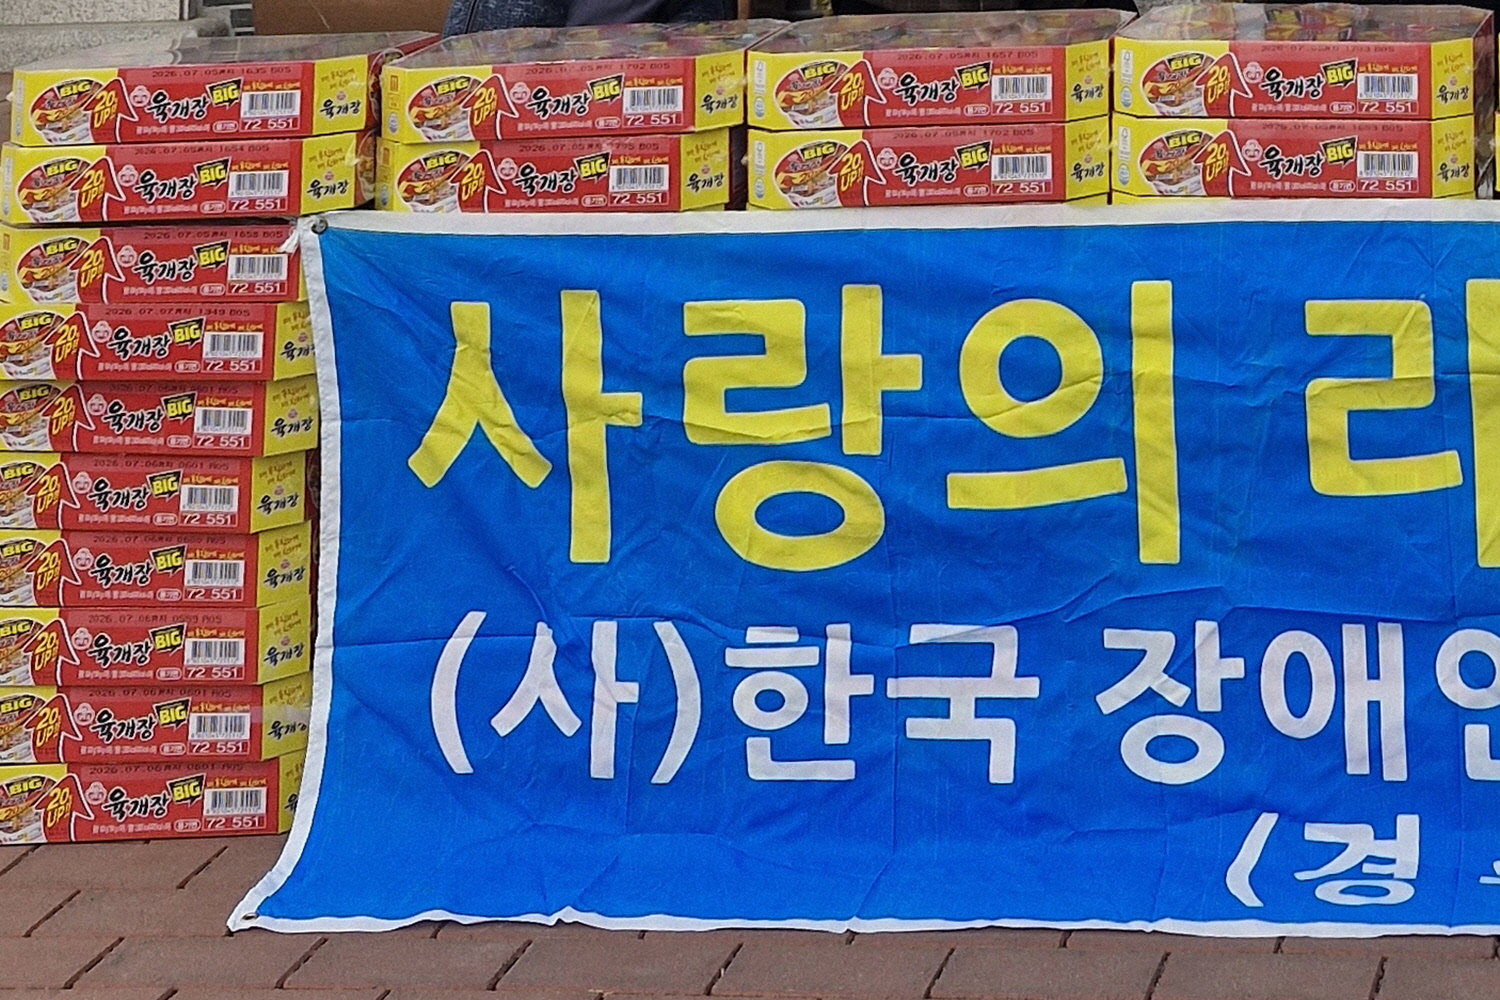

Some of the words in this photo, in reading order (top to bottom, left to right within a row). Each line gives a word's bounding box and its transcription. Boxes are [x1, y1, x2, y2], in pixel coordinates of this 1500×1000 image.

[804, 63, 836, 80] BIG
[1170, 55, 1201, 71] BIG
[59, 81, 90, 98] BIG
[437, 78, 469, 95] BIG
[895, 70, 959, 104] 육개장
[960, 68, 988, 87] BIG
[1261, 67, 1324, 99] 육개장
[1325, 66, 1354, 84] BIG
[147, 87, 210, 121] 육개장
[211, 85, 238, 104] BIG
[527, 83, 591, 118] 육개장
[591, 81, 620, 100] BIG
[701, 94, 739, 113] 육개장
[995, 103, 1013, 113] 72
[1020, 102, 1045, 113] 551
[1360, 101, 1379, 111] 72
[1386, 101, 1411, 113] 551
[320, 99, 361, 119] 육개장
[244, 119, 261, 129] 72
[268, 117, 293, 129] 551
[626, 114, 644, 125] 72
[651, 113, 676, 125] 551
[1168, 132, 1200, 149] BIG
[803, 143, 835, 160] BIG
[1260, 144, 1324, 177] 육개장
[1325, 143, 1353, 162] BIG
[46, 160, 78, 177] BIG
[426, 153, 457, 169] BIG
[894, 150, 958, 185] 육개장
[959, 148, 988, 167] BIG
[515, 161, 577, 194] 육개장
[578, 159, 606, 177] BIG
[1070, 163, 1104, 183] 육개장
[134, 167, 198, 201] 육개장
[198, 165, 226, 184] BIG
[306, 179, 348, 199] 육개장
[995, 183, 1013, 193] 72
[1020, 181, 1045, 193] 551
[1360, 179, 1378, 190] 72
[1386, 180, 1411, 191] 551
[231, 199, 249, 210] 72
[255, 198, 280, 210] 551
[612, 193, 630, 203] 72
[637, 192, 662, 203] 551
[46, 240, 77, 256] BIG
[134, 249, 197, 282] 육개장
[197, 247, 225, 266] BIG
[230, 282, 248, 293] 72
[255, 282, 279, 293] 551
[20, 314, 52, 330] BIG
[108, 325, 172, 358] 육개장
[172, 324, 200, 343] BIG
[206, 360, 223, 370] 72
[230, 360, 255, 371] 551
[103, 400, 165, 432] 육개장
[165, 399, 192, 417] BIG
[271, 418, 314, 437] 육개장
[410, 283, 1178, 570] 사랑의
[197, 435, 214, 446] 72
[220, 436, 244, 447] 551
[89, 477, 150, 510] 육개장
[151, 477, 178, 495] BIG
[183, 513, 200, 523] 72
[206, 513, 231, 525] 551
[90, 553, 154, 586] 육개장
[154, 552, 182, 571] BIG
[187, 588, 205, 598] 72
[211, 588, 236, 600] 551
[88, 632, 152, 666] 육개장
[153, 631, 181, 650] BIG
[263, 643, 305, 664] 육개장
[187, 667, 205, 677] 72
[211, 667, 237, 678] 551
[432, 612, 1038, 783] (사)한국
[91, 707, 157, 741] 육개장
[157, 706, 186, 725] BIG
[191, 742, 210, 752] 72
[216, 741, 242, 753] 551
[103, 784, 170, 820] 육개장
[171, 782, 201, 802] BIG
[206, 817, 225, 828] 72
[232, 816, 258, 828] 551
